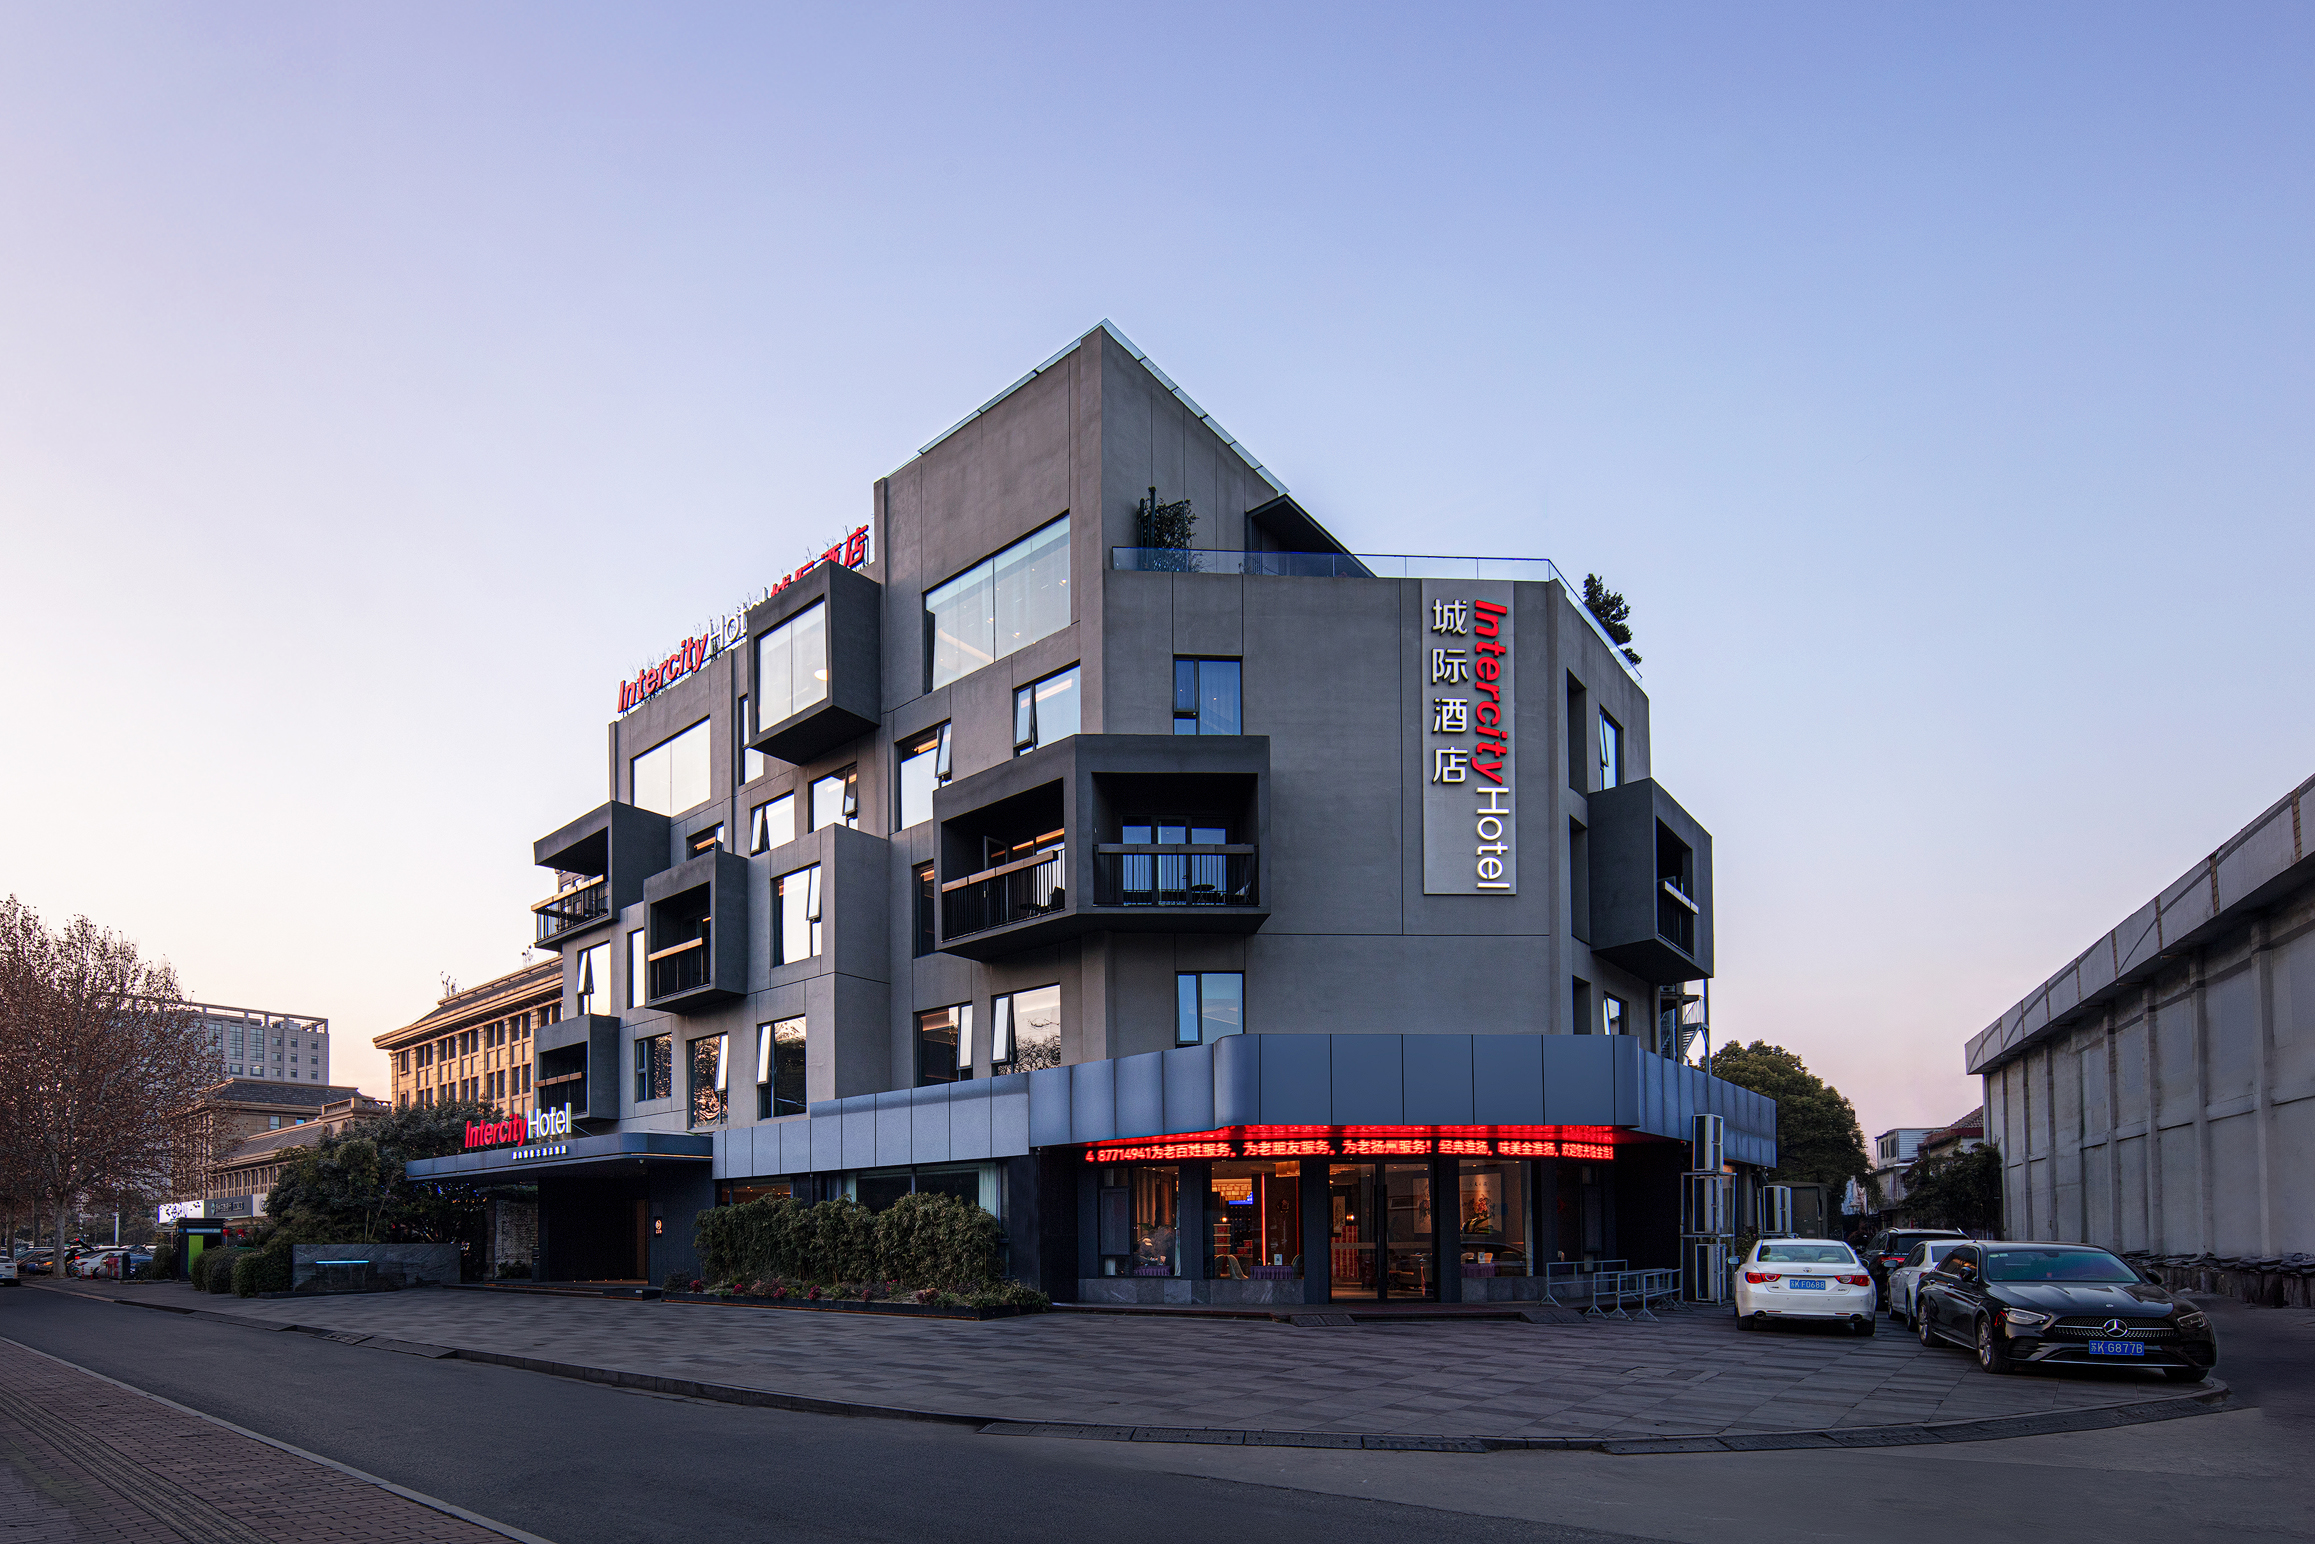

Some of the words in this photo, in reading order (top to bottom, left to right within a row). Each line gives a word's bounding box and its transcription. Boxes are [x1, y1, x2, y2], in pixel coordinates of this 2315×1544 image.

[617, 586, 768, 713] IntercityHot
[1431, 598, 1468, 784] 城际酒店
[1472, 599, 1510, 889] IntercityHotel
[465, 1102, 571, 1147] IntercityHotel
[1085, 1151, 1095, 1163] 4
